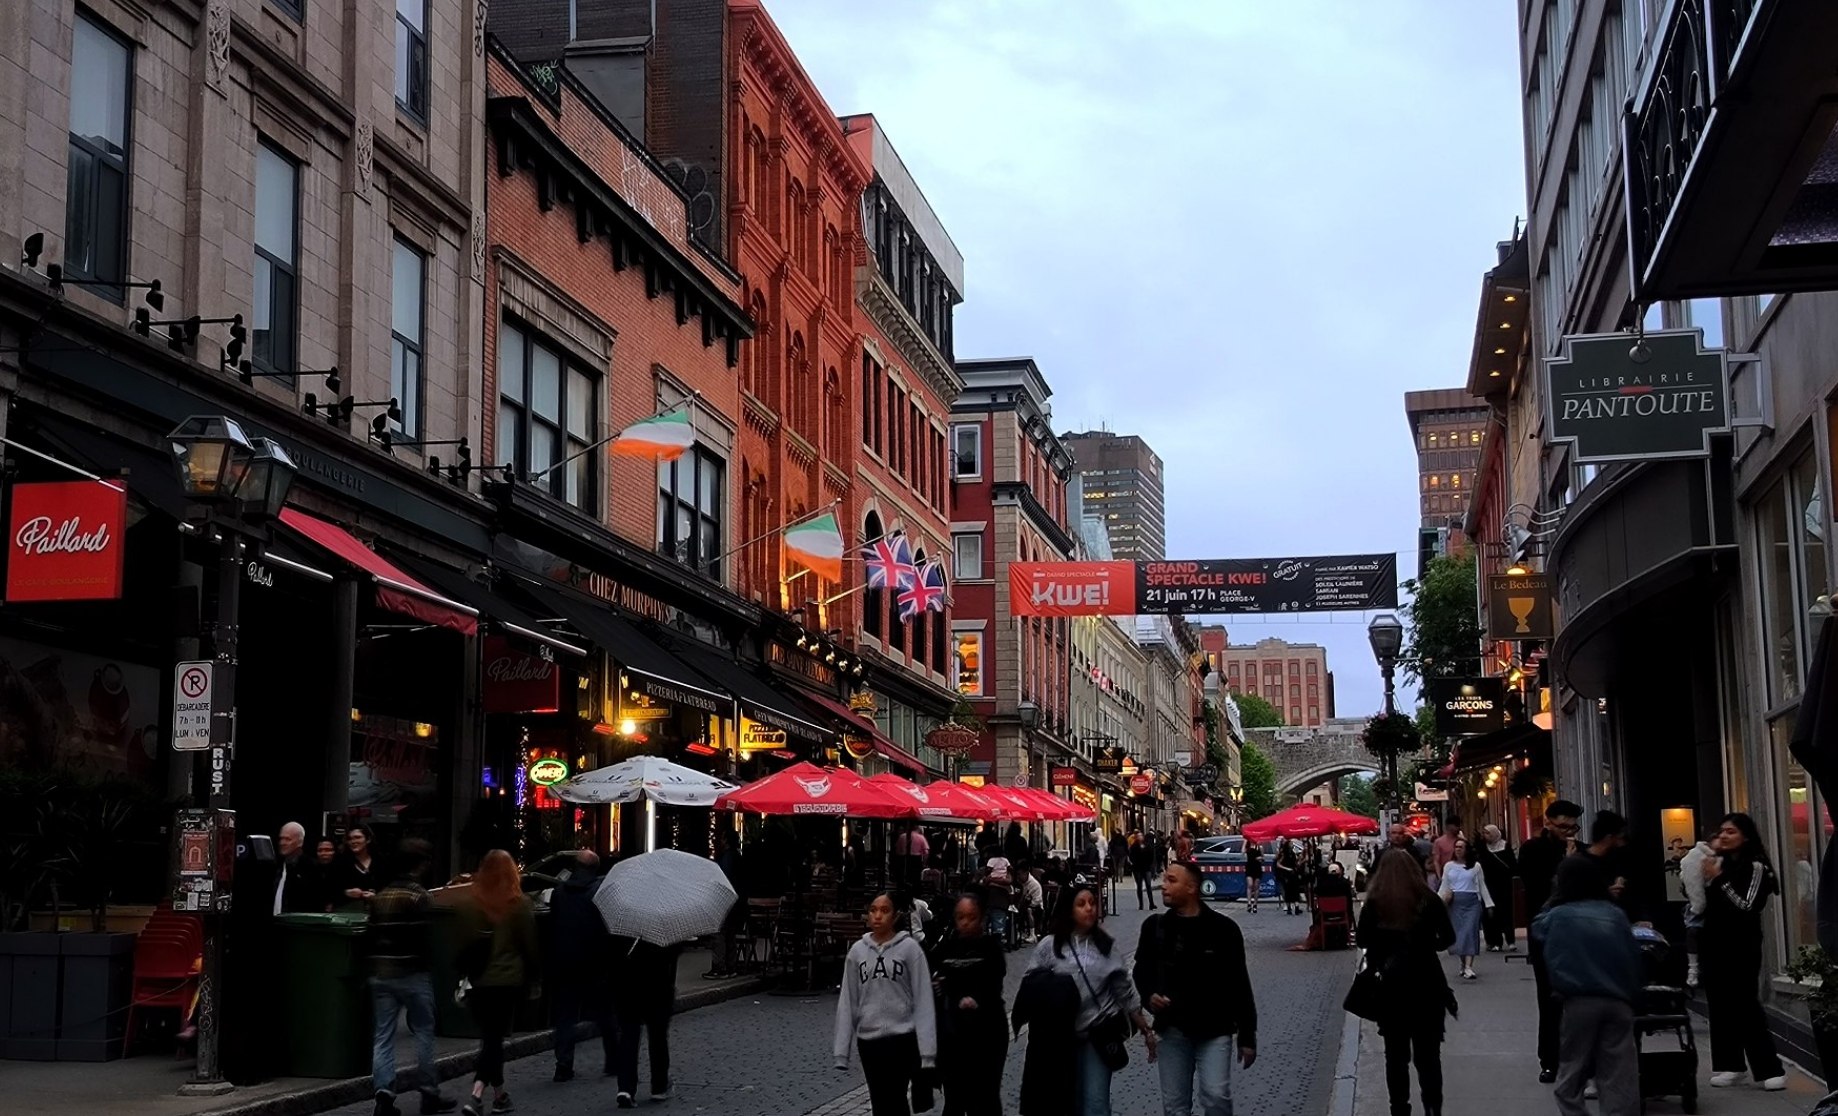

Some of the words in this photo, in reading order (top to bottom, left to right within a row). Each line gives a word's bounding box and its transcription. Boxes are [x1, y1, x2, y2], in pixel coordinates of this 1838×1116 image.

[1579, 371, 1695, 389] LIBRAIRIE
[1561, 391, 1715, 421] PANTOUTE
[16, 516, 111, 555] Paillard
[1146, 562, 1199, 574] GRAND
[1273, 562, 1303, 579] GRATUIT
[1146, 574, 1224, 586] SPECTACLE
[1228, 573, 1267, 585] KWE!
[1494, 581, 1507, 590] Le
[1509, 579, 1548, 590] Bedeau
[589, 570, 619, 604] CHEZ
[620, 583, 672, 626] MURPHY'S
[1032, 580, 1110, 606] KWE!
[1146, 589, 1161, 601] 21
[1164, 589, 1188, 604] juin
[487, 656, 552, 683] Paillard
[196, 729, 209, 738] VEN
[212, 747, 224, 795] RUST
[859, 956, 904, 984] GAP
